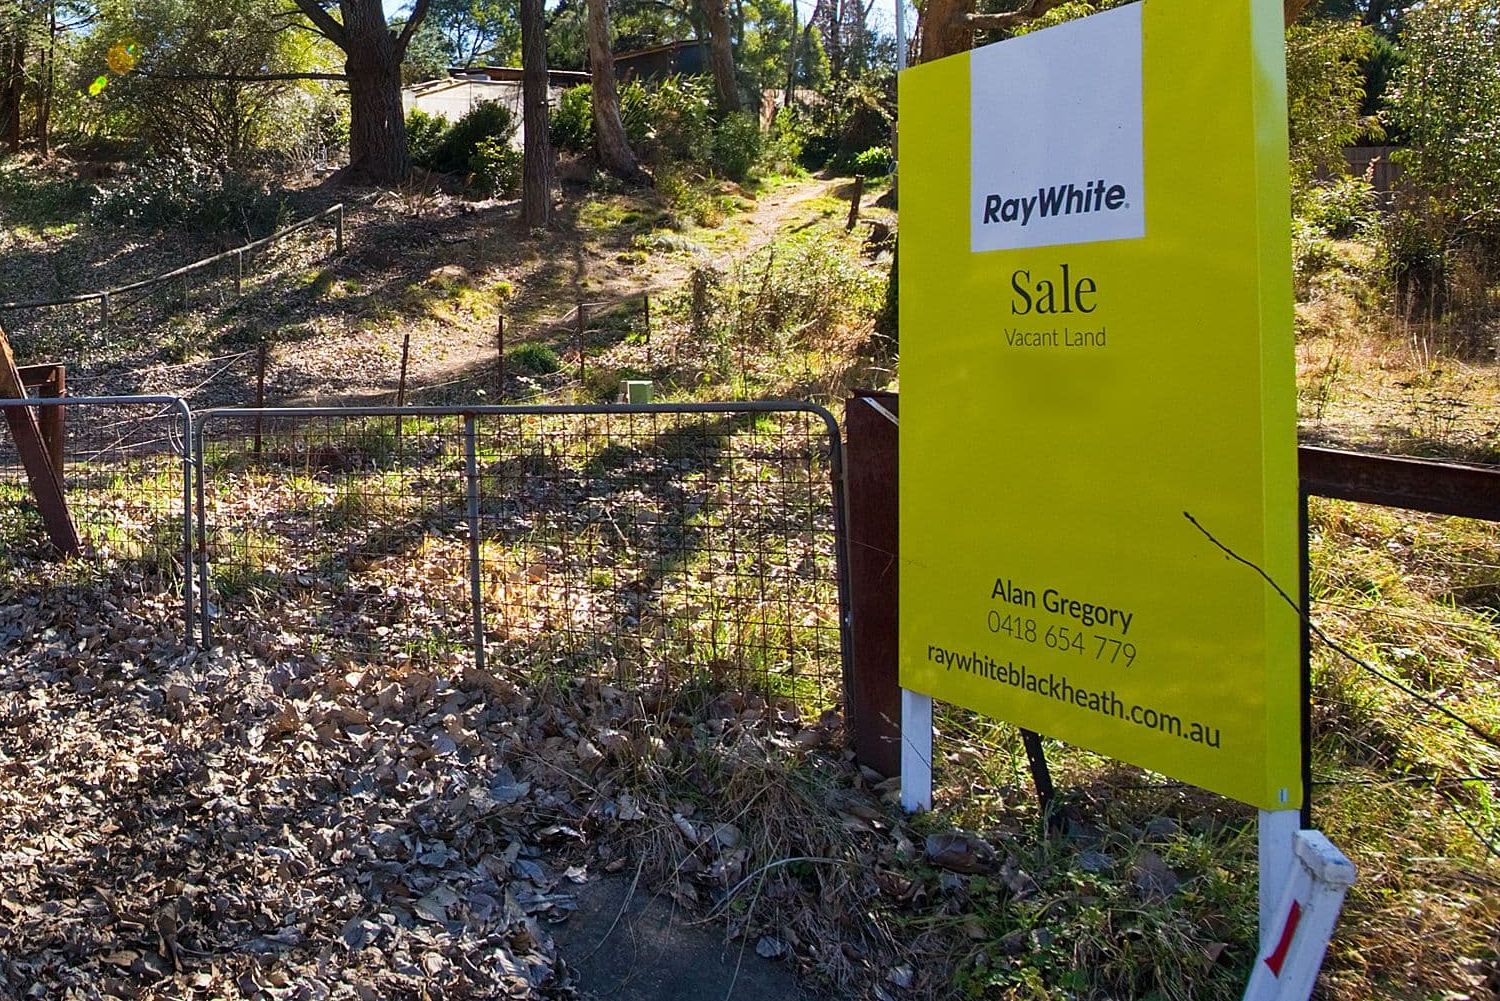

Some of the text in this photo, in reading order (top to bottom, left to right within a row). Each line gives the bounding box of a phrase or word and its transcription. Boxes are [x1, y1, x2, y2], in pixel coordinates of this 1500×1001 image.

[1011, 263, 1097, 316] Sale
[1004, 326, 1106, 347] Vacant Land
[991, 578, 1133, 635] Alan Gregory
[987, 610, 1137, 668] 0418 654 779
[928, 643, 1221, 749] raywhiteblackheath.com.au
